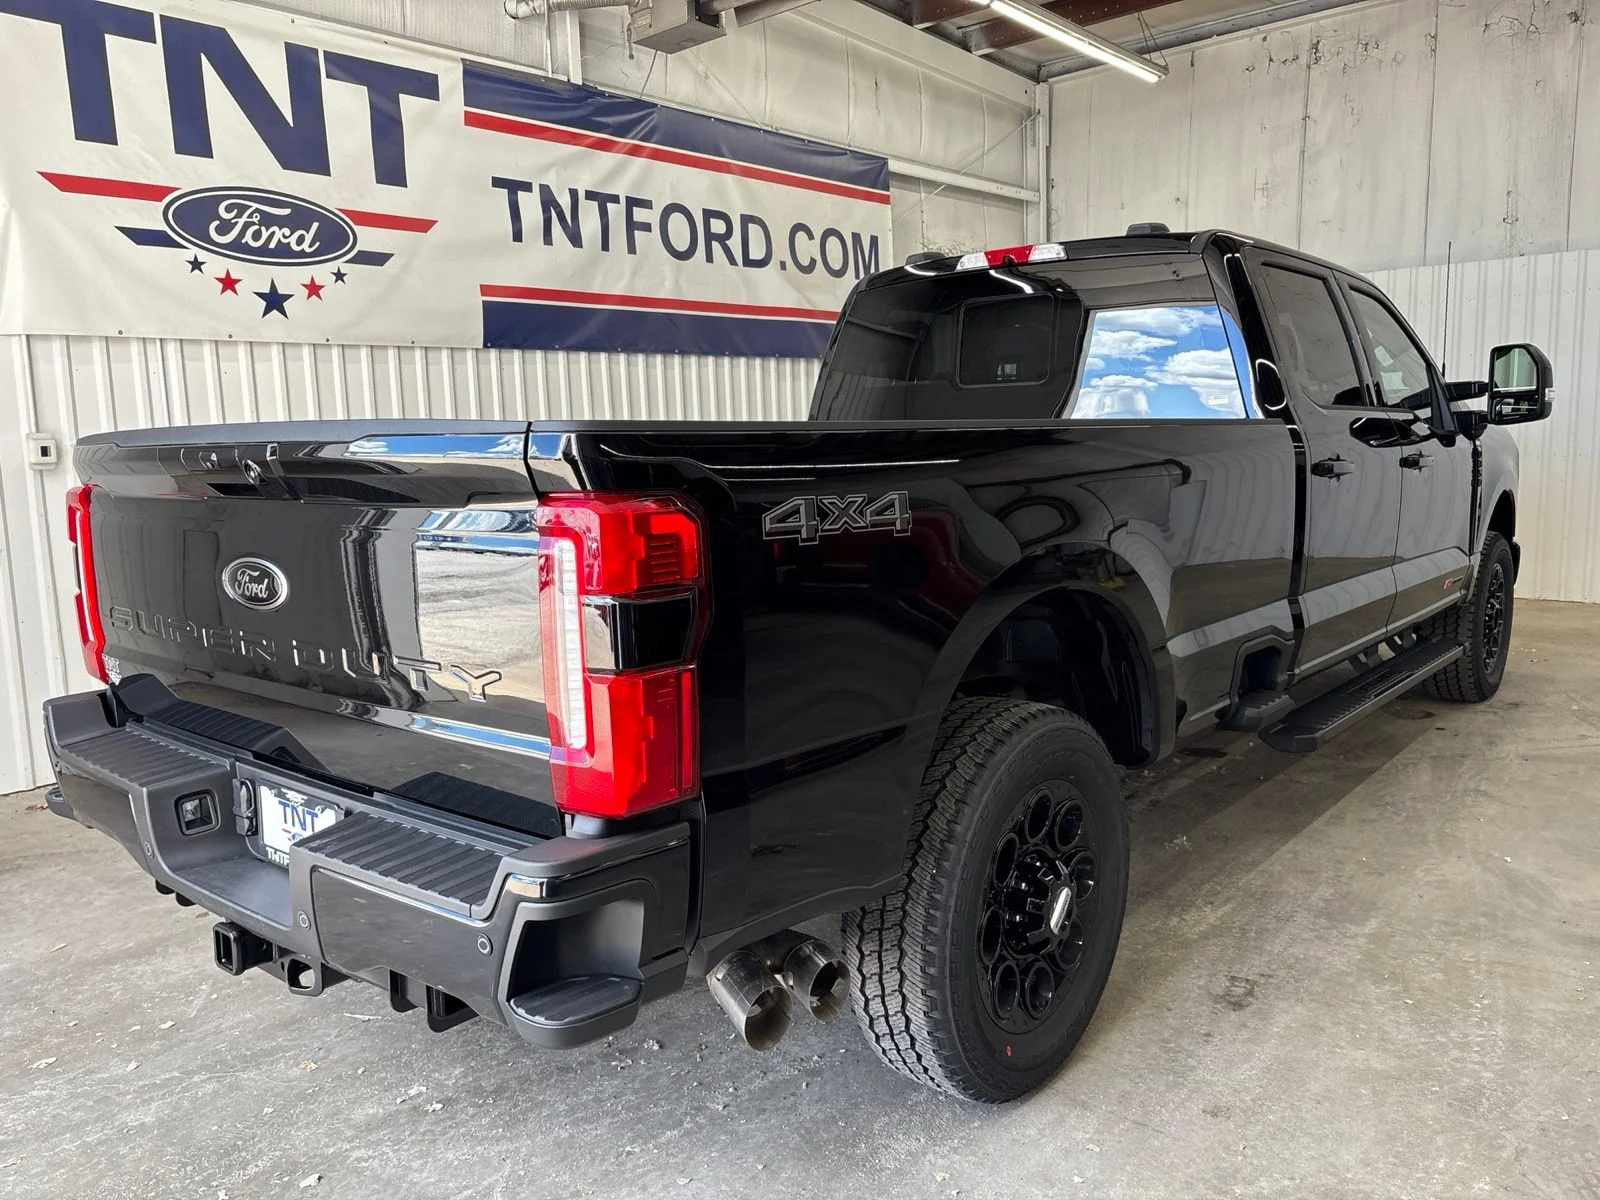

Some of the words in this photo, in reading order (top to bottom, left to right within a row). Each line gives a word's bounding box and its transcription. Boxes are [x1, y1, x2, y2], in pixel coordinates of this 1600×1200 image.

[0, 0, 440, 188] TNT
[208, 199, 321, 253] Ford
[491, 176, 881, 281] TNTFORD.COM
[235, 568, 268, 598] Ford
[110, 606, 277, 662] SUPER
[292, 639, 503, 702] DUTY
[278, 800, 319, 833] TNT
